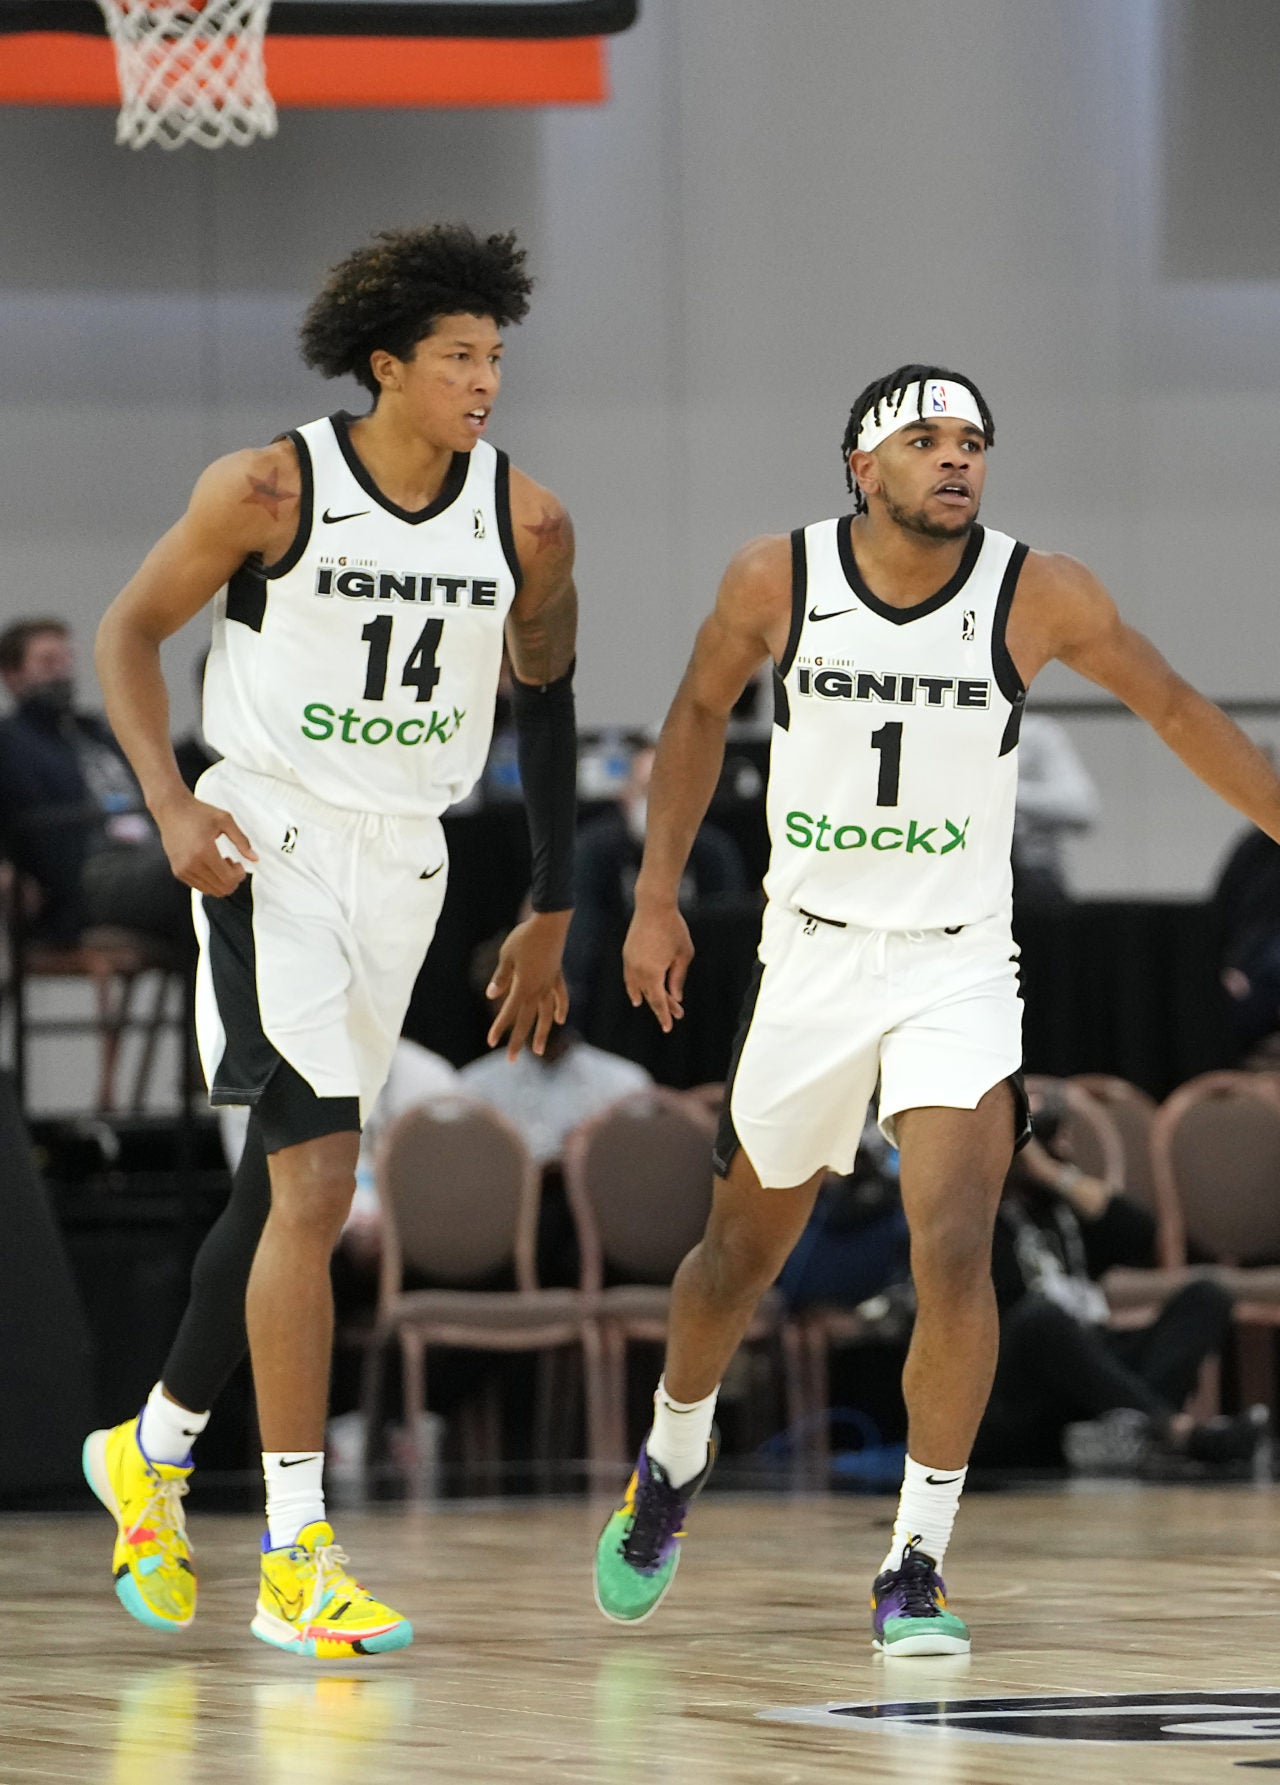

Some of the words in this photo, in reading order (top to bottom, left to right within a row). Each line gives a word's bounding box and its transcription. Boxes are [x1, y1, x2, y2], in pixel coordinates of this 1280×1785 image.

[316, 567, 499, 609] IGNITE
[361, 614, 445, 702] 14
[797, 666, 992, 710] IGNITE
[301, 703, 466, 746] StockX
[871, 721, 904, 807] 1
[785, 811, 971, 855] StockX
